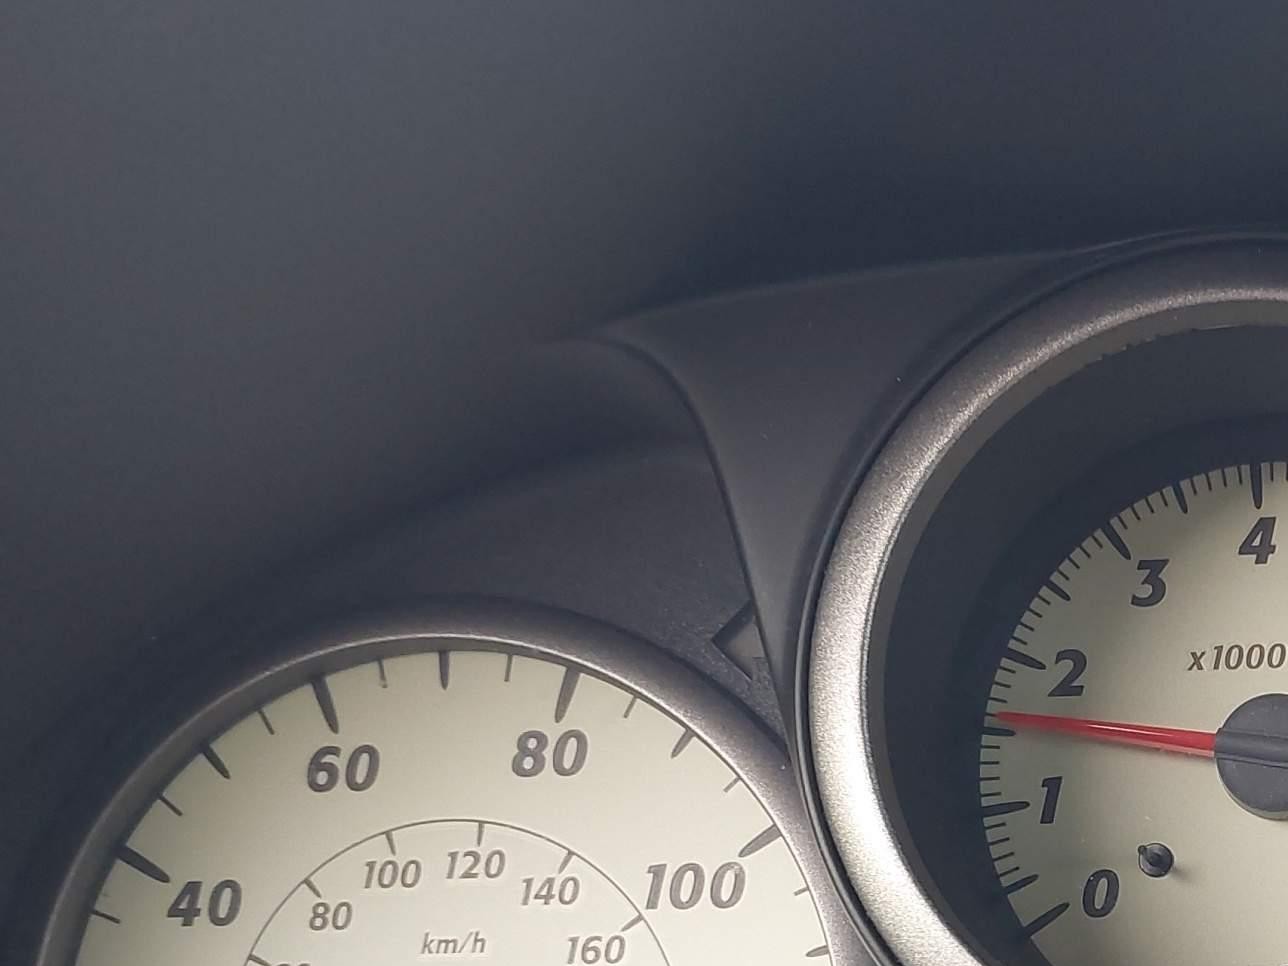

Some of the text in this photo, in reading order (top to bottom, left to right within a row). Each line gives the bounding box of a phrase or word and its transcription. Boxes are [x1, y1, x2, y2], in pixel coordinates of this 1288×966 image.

[1238, 517, 1276, 564] 4
[1131, 558, 1168, 608] 3
[1047, 649, 1087, 697] 2
[306, 744, 380, 792] 60
[510, 729, 589, 778] 80
[1039, 775, 1062, 825] 1
[362, 858, 422, 891] 100
[444, 849, 506, 882] 120
[645, 861, 746, 911] 100
[166, 878, 242, 929] 40
[520, 875, 581, 907] 140
[1082, 869, 1119, 918] 0
[308, 901, 352, 932] 80
[419, 929, 487, 958] km/h
[565, 934, 626, 966] 160
